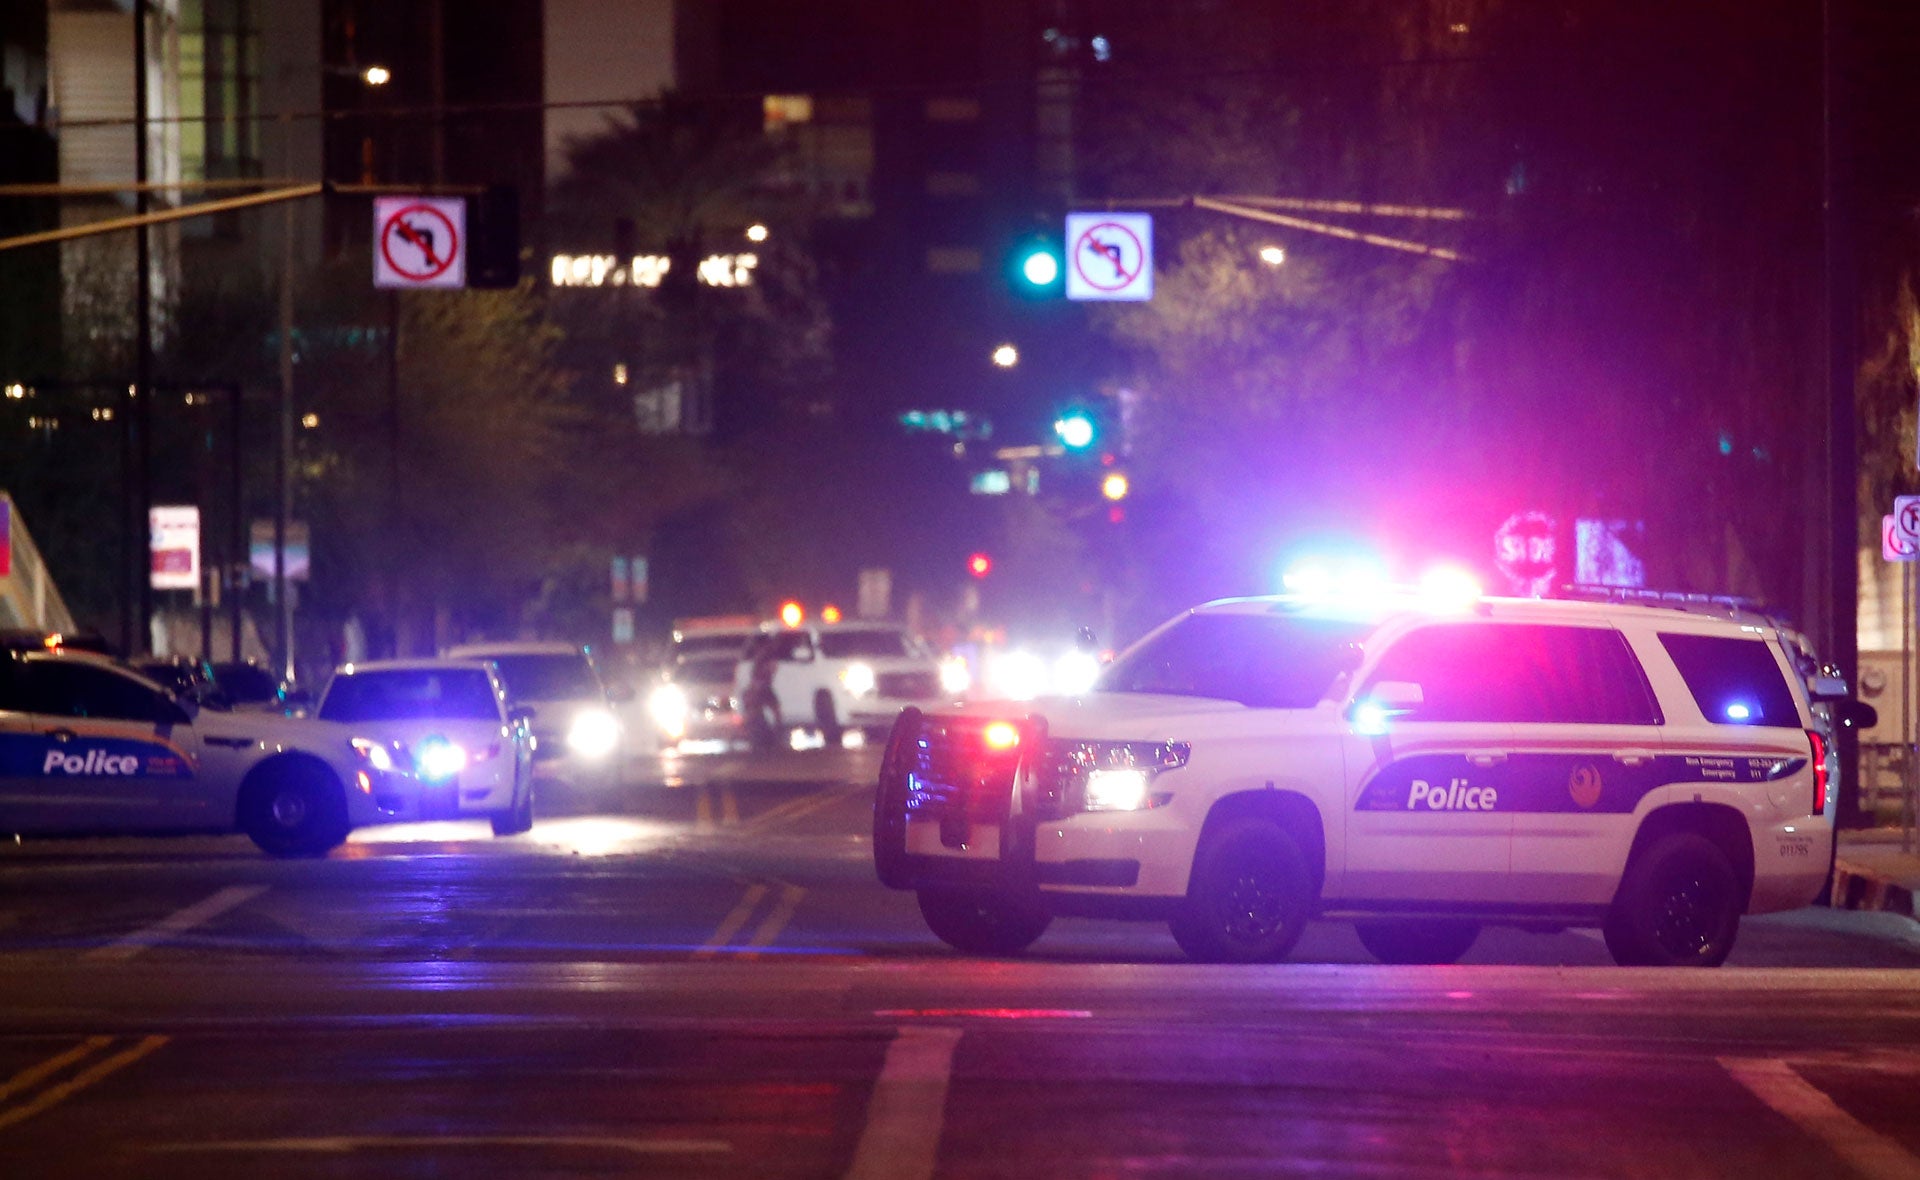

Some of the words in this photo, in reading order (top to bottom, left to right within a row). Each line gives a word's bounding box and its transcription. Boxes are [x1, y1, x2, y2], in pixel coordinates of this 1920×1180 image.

[43, 748, 139, 775] Police
[1702, 768, 1736, 779] Emergency
[1407, 778, 1498, 811] Police
